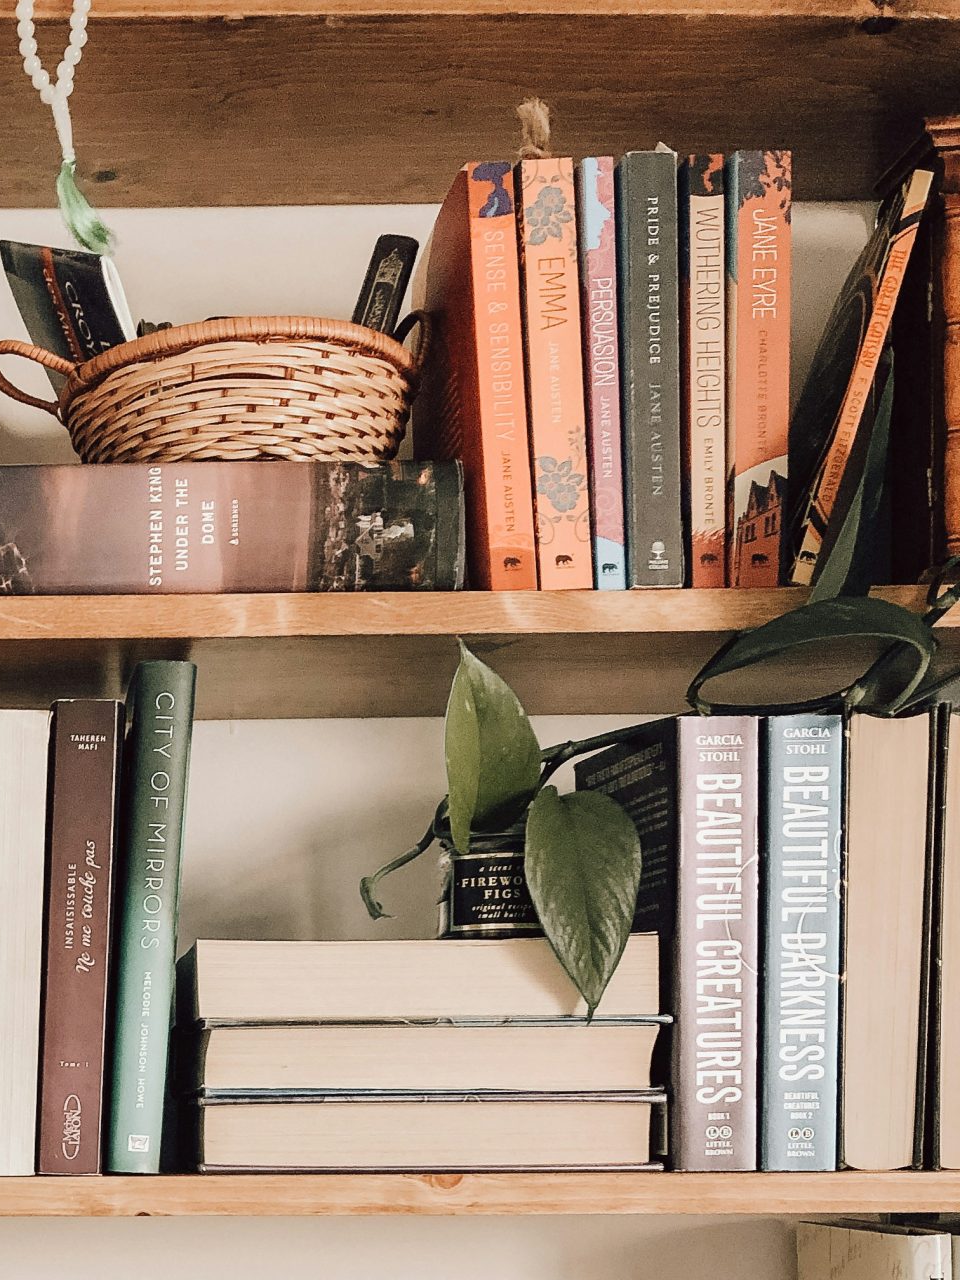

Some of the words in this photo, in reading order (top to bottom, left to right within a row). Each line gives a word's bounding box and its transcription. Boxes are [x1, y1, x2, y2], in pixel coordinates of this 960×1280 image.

[647, 195, 659, 248] PRIDE
[753, 209, 777, 261] JANE
[538, 257, 566, 331] EMMA
[695, 207, 722, 331] WUTHERING
[752, 267, 777, 319] EYRE
[592, 277, 616, 386] PERSUASION
[647, 274, 661, 365] PREJUDICE
[648, 383, 662, 425] JANE
[695, 340, 721, 428] HEIGHTS
[150, 465, 162, 503] KING
[176, 478, 188, 511] THE
[650, 432, 664, 496] AUSTEN
[149, 505, 162, 588] STEPHEN
[176, 513, 189, 572] UNDER
[201, 499, 214, 545] DOME
[152, 692, 175, 758] CITY
[82, 840, 97, 868] pas
[696, 773, 742, 929] BEAUTIFUL
[782, 766, 829, 922] BEAUTIFUL
[65, 862, 76, 950] INSAISISSABLE
[140, 822, 167, 950] MIRRORS
[483, 889, 522, 899] FIGS
[696, 941, 742, 1103] CREATURES
[779, 933, 826, 1081] DARKNESS
